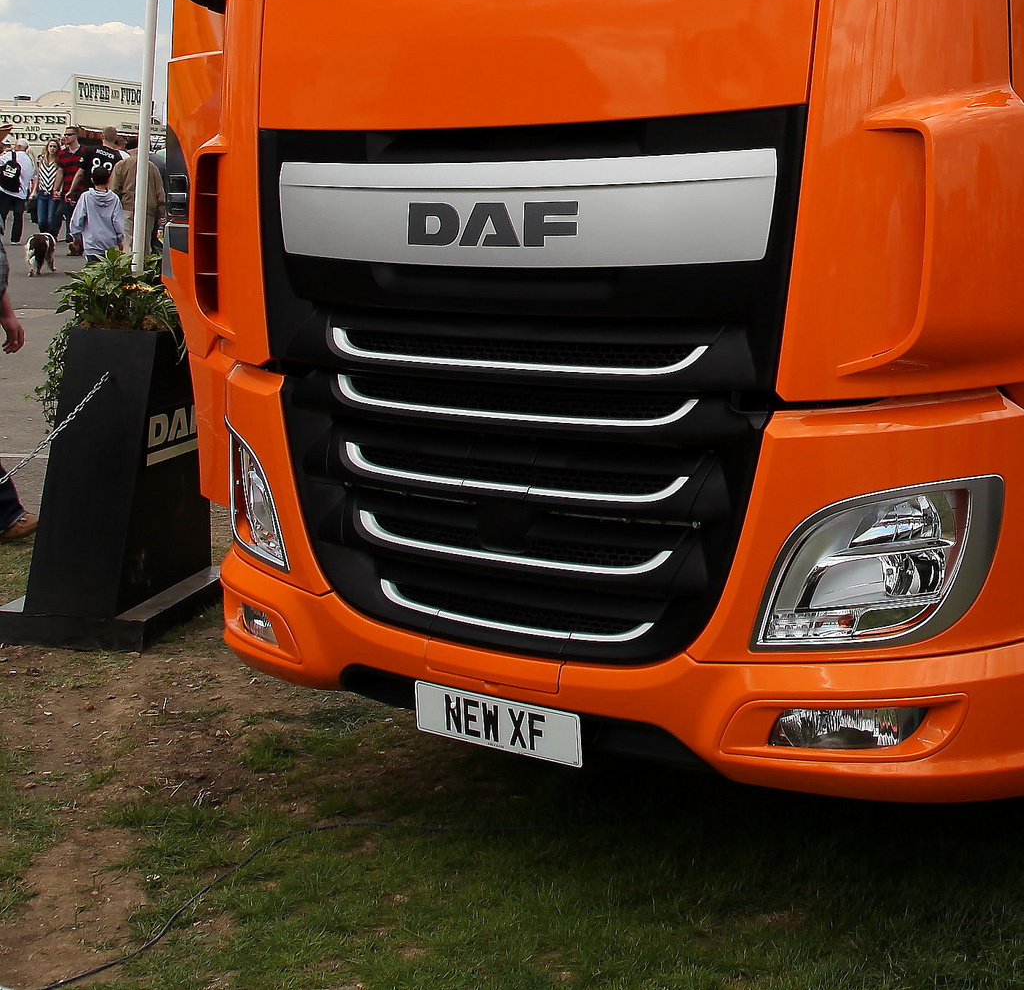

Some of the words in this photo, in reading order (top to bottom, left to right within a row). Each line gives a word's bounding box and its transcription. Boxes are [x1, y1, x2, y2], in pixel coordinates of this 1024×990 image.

[78, 82, 109, 102] TOFFEE
[121, 87, 141, 105] FUDG
[1, 114, 66, 124] TOFFEE
[407, 200, 579, 248] DAF
[445, 694, 500, 743] NEW
[508, 707, 546, 751] XF
